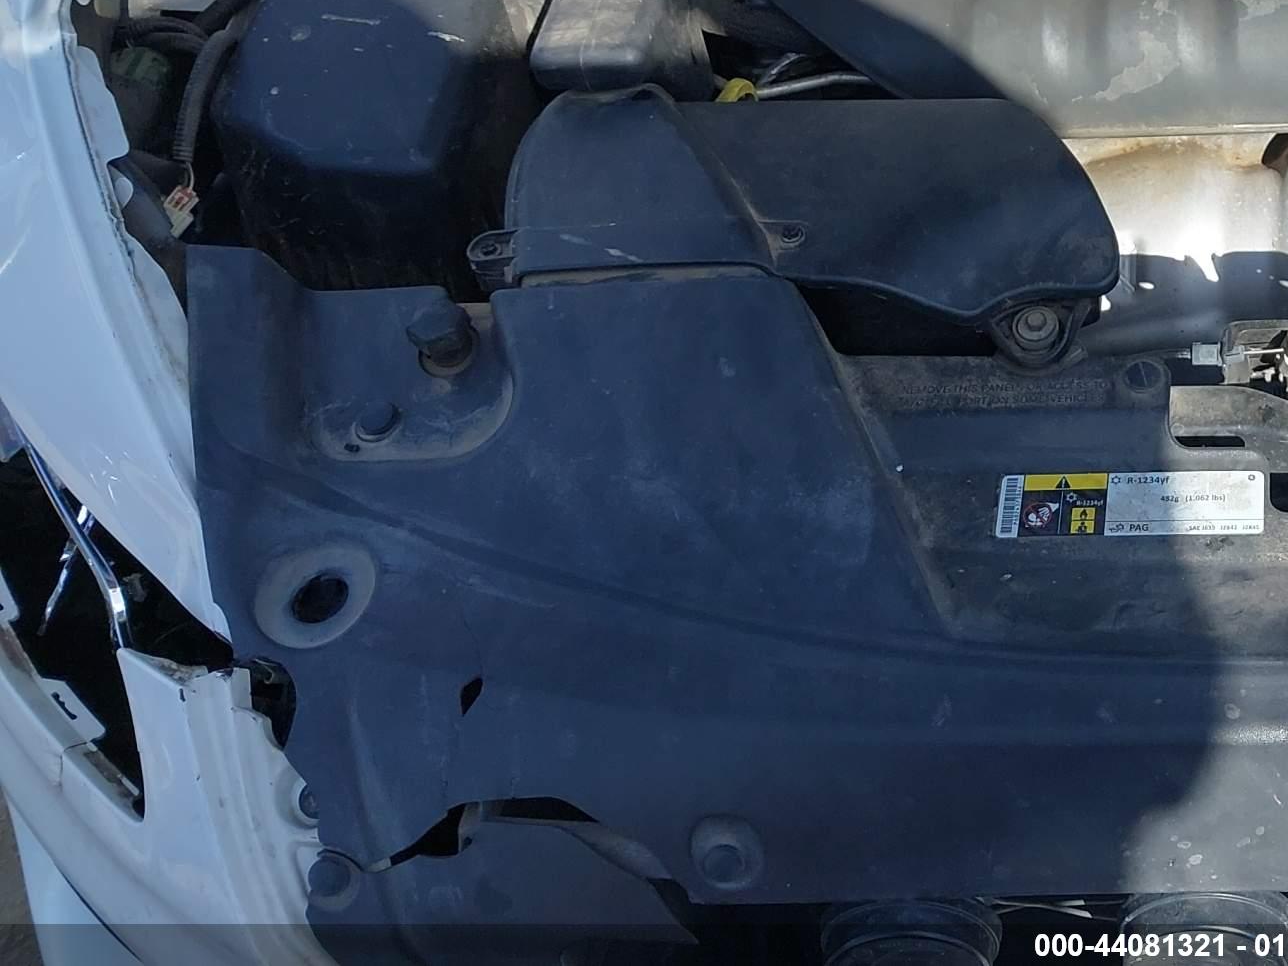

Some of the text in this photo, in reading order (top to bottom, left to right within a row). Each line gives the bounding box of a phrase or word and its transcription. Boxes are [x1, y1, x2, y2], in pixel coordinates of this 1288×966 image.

[954, 384, 978, 394] THIS
[981, 383, 1015, 393] PANEL
[1127, 475, 1170, 485] R-1234yf
[1211, 494, 1226, 502] lbs)
[1076, 499, 1104, 507] R-1234yf
[1129, 523, 1149, 532] PAG
